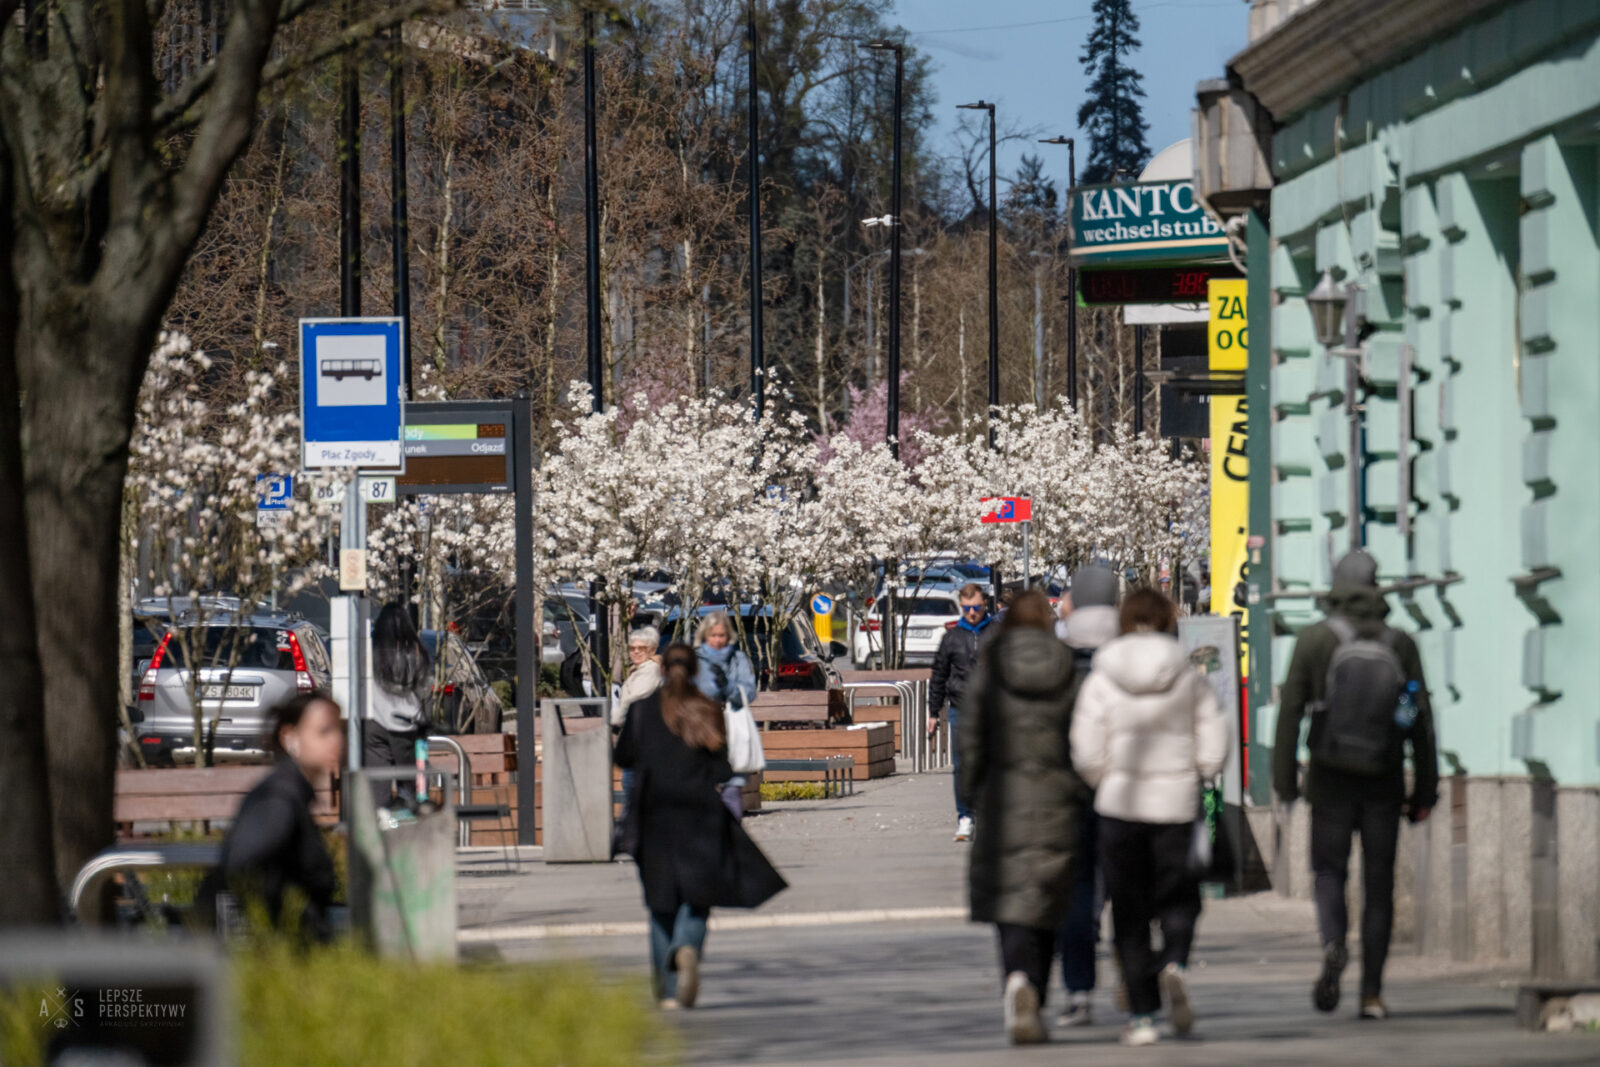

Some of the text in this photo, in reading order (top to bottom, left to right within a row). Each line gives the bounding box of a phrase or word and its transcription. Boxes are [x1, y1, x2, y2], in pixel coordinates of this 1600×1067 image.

[1081, 183, 1201, 221] KANTO
[320, 448, 376, 462] Plac Zgody
[471, 442, 505, 454] Odjazd
[372, 482, 388, 498] 87
